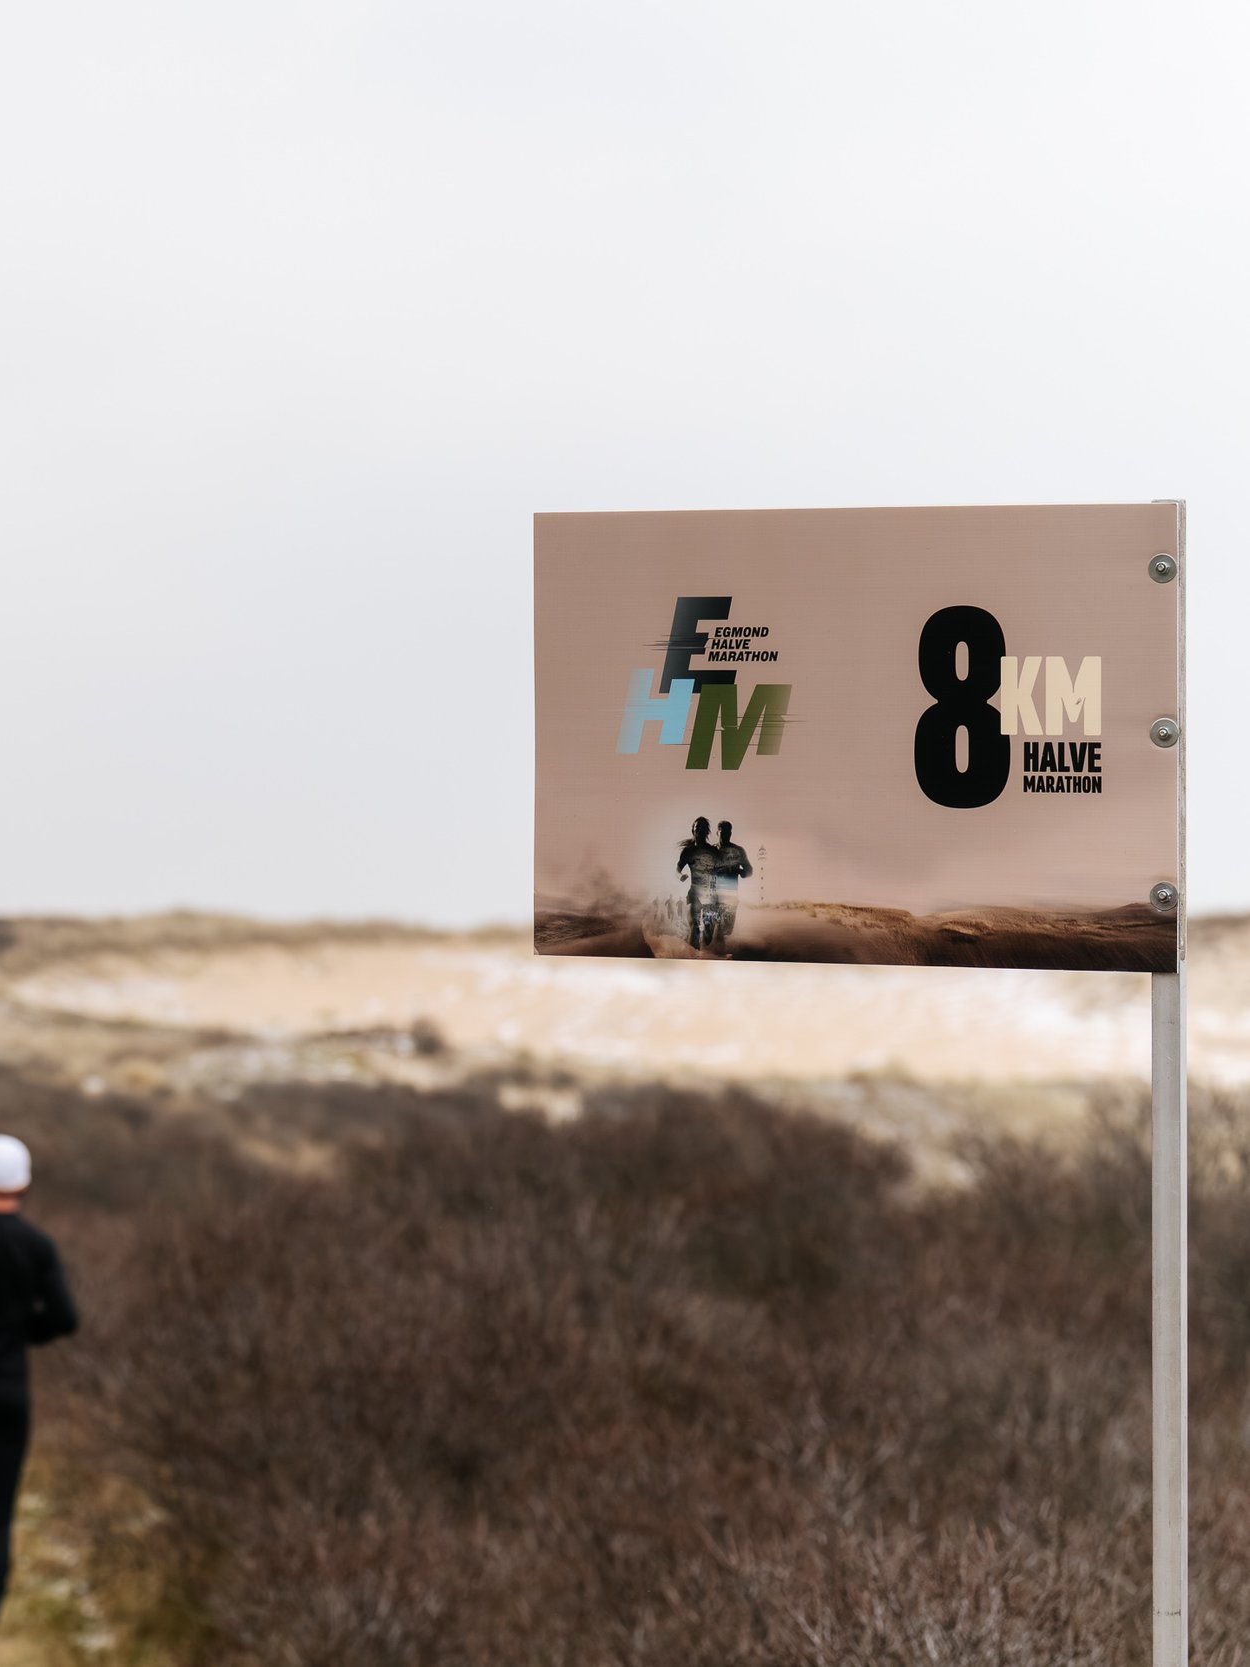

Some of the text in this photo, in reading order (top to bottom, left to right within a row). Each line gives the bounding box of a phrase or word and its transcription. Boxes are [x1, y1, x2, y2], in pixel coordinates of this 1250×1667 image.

[714, 626, 769, 638] EGMOND
[711, 639, 751, 650] HALVE
[707, 651, 779, 662] MARATHON
[1023, 741, 1101, 773] HALVE
[1022, 775, 1102, 793] MARATHON
